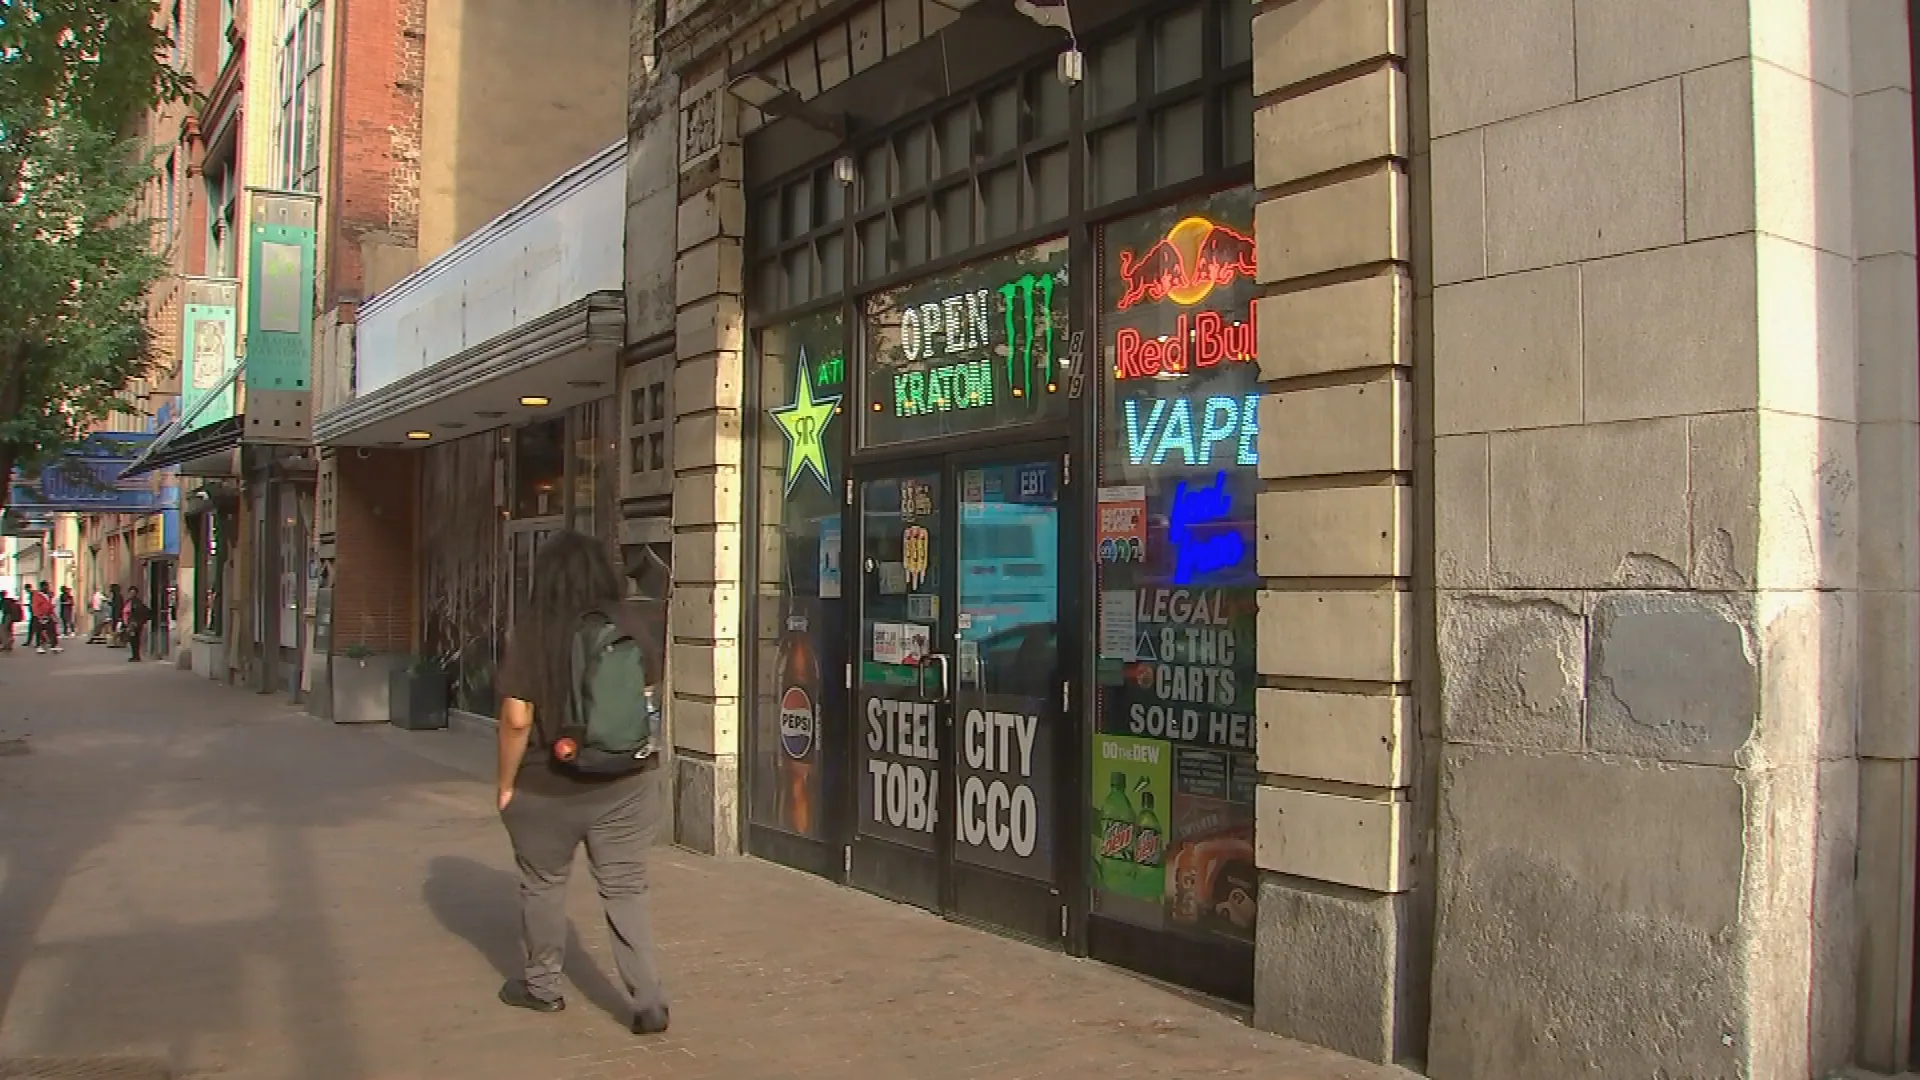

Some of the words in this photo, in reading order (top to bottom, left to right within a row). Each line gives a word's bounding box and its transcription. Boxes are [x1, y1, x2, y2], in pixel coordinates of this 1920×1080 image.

[902, 289, 989, 361] OPEN
[1115, 312, 1188, 379] Red
[1195, 299, 1259, 367] Bul
[818, 359, 844, 386] AT
[894, 359, 993, 417] KRATOM
[1020, 470, 1047, 495] EBT
[1138, 588, 1228, 625] LEGAL
[1155, 664, 1235, 706] CARTS
[782, 713, 811, 732] PEPSI
[867, 697, 939, 761] STEEL
[964, 709, 1038, 777] CITY
[1129, 703, 1199, 741] SOLD
[1208, 711, 1257, 749] HE
[1133, 744, 1160, 764] DEW
